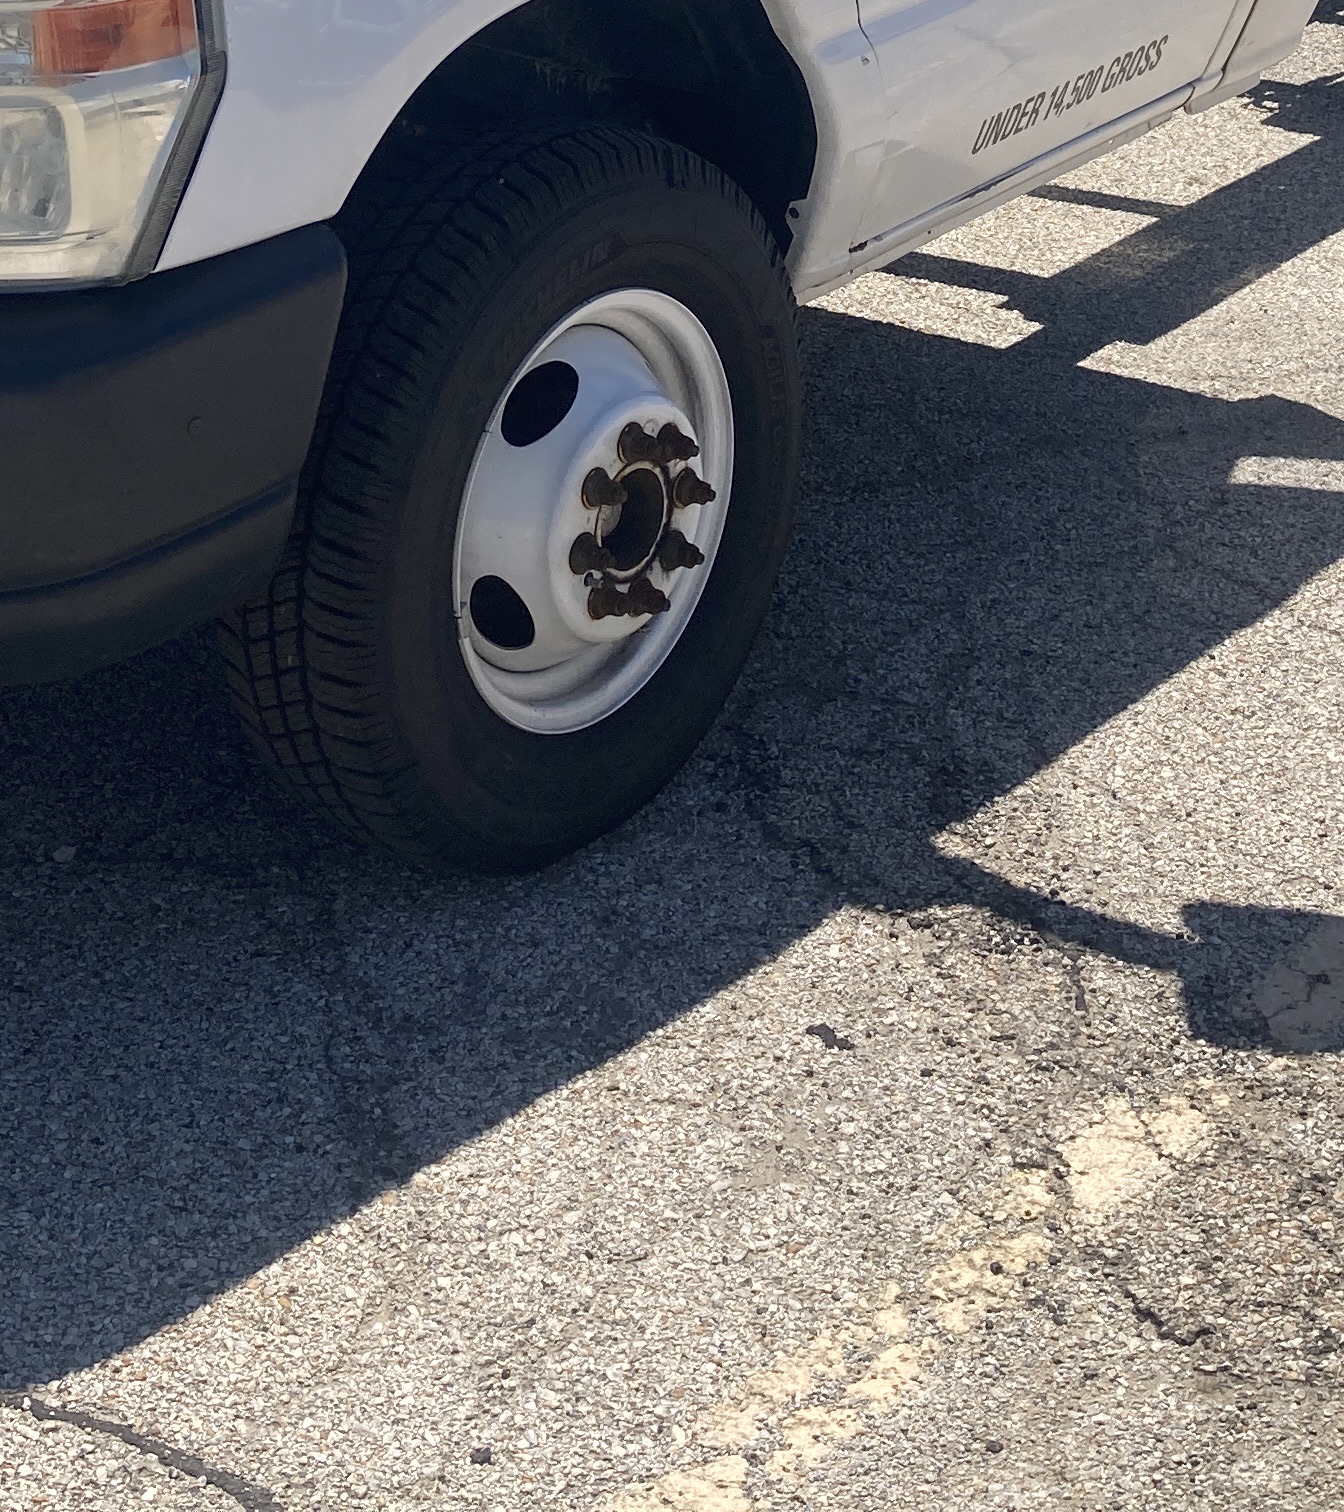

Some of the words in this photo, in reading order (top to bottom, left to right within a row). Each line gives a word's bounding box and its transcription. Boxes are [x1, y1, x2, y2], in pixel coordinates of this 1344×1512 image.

[972, 91, 1046, 155] UNDER
[1043, 64, 1105, 121] 14,500
[1101, 34, 1168, 94] GROSS
